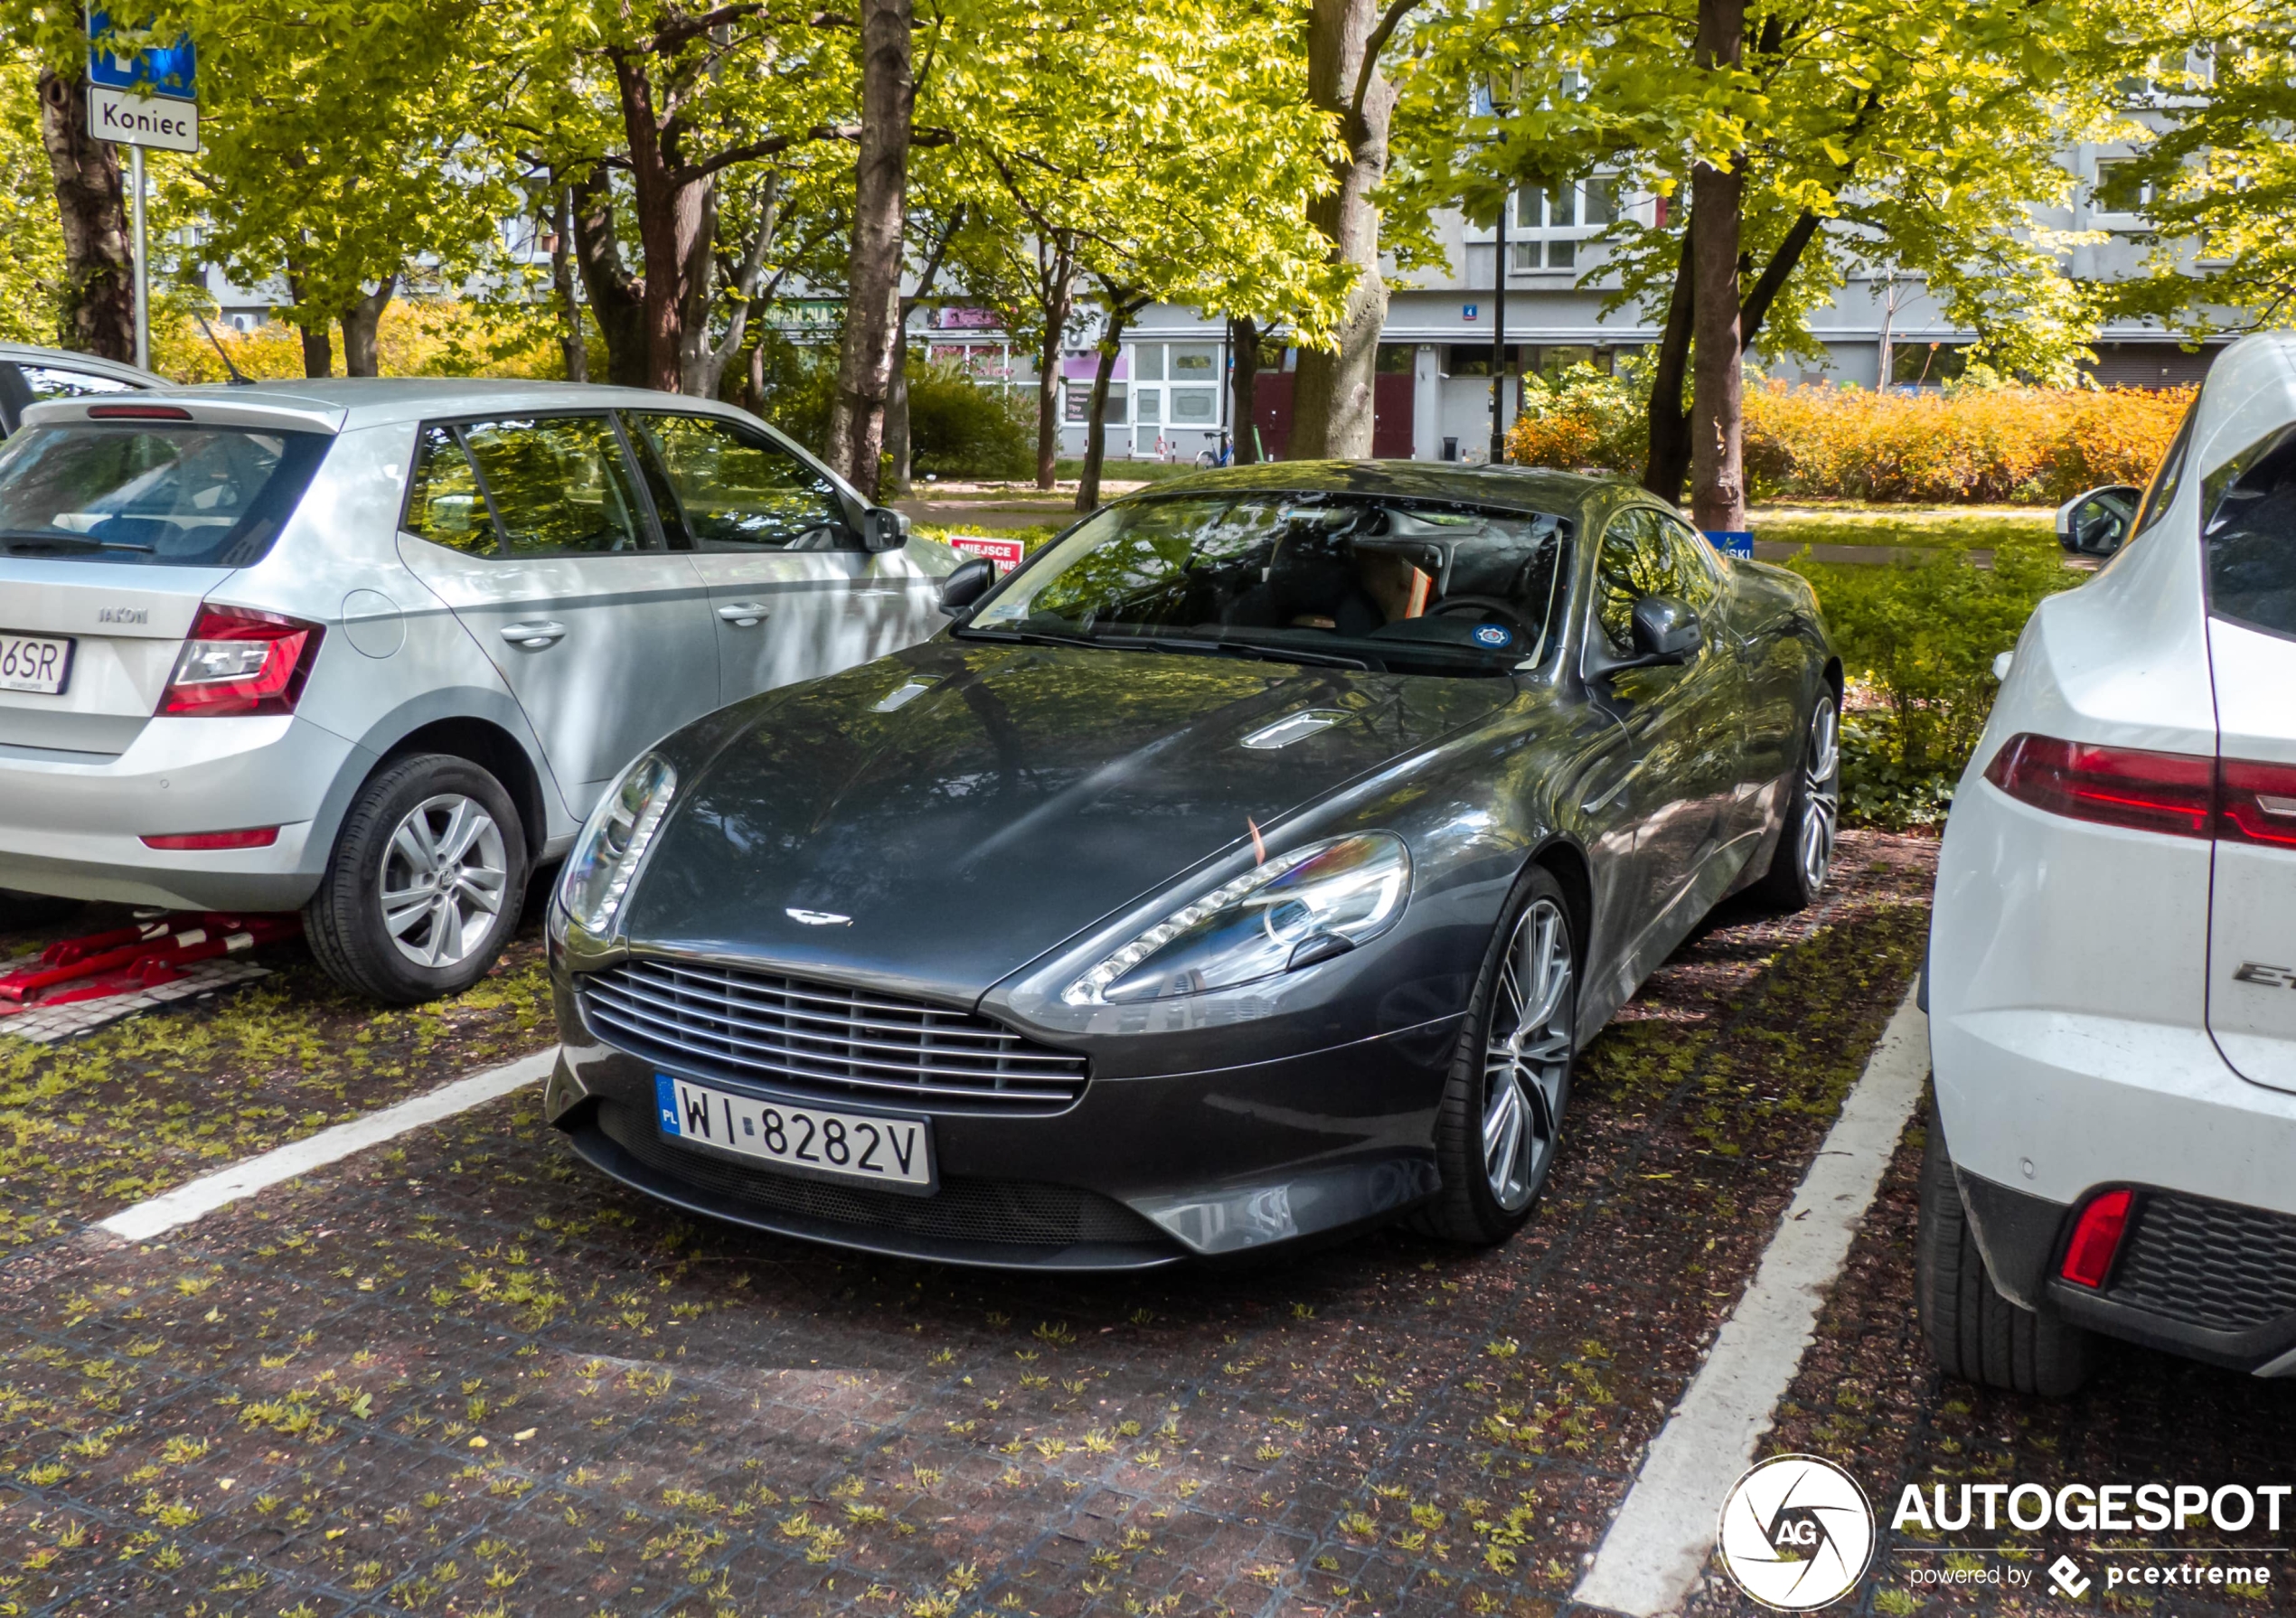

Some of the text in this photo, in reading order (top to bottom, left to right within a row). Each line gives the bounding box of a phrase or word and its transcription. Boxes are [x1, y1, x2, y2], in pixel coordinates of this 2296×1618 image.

[102, 102, 186, 136] Koniec
[959, 543, 1012, 557] MIEJSCE
[1718, 549, 1750, 560] SKI
[0, 640, 58, 682] 6SR
[663, 1109, 678, 1124] PL
